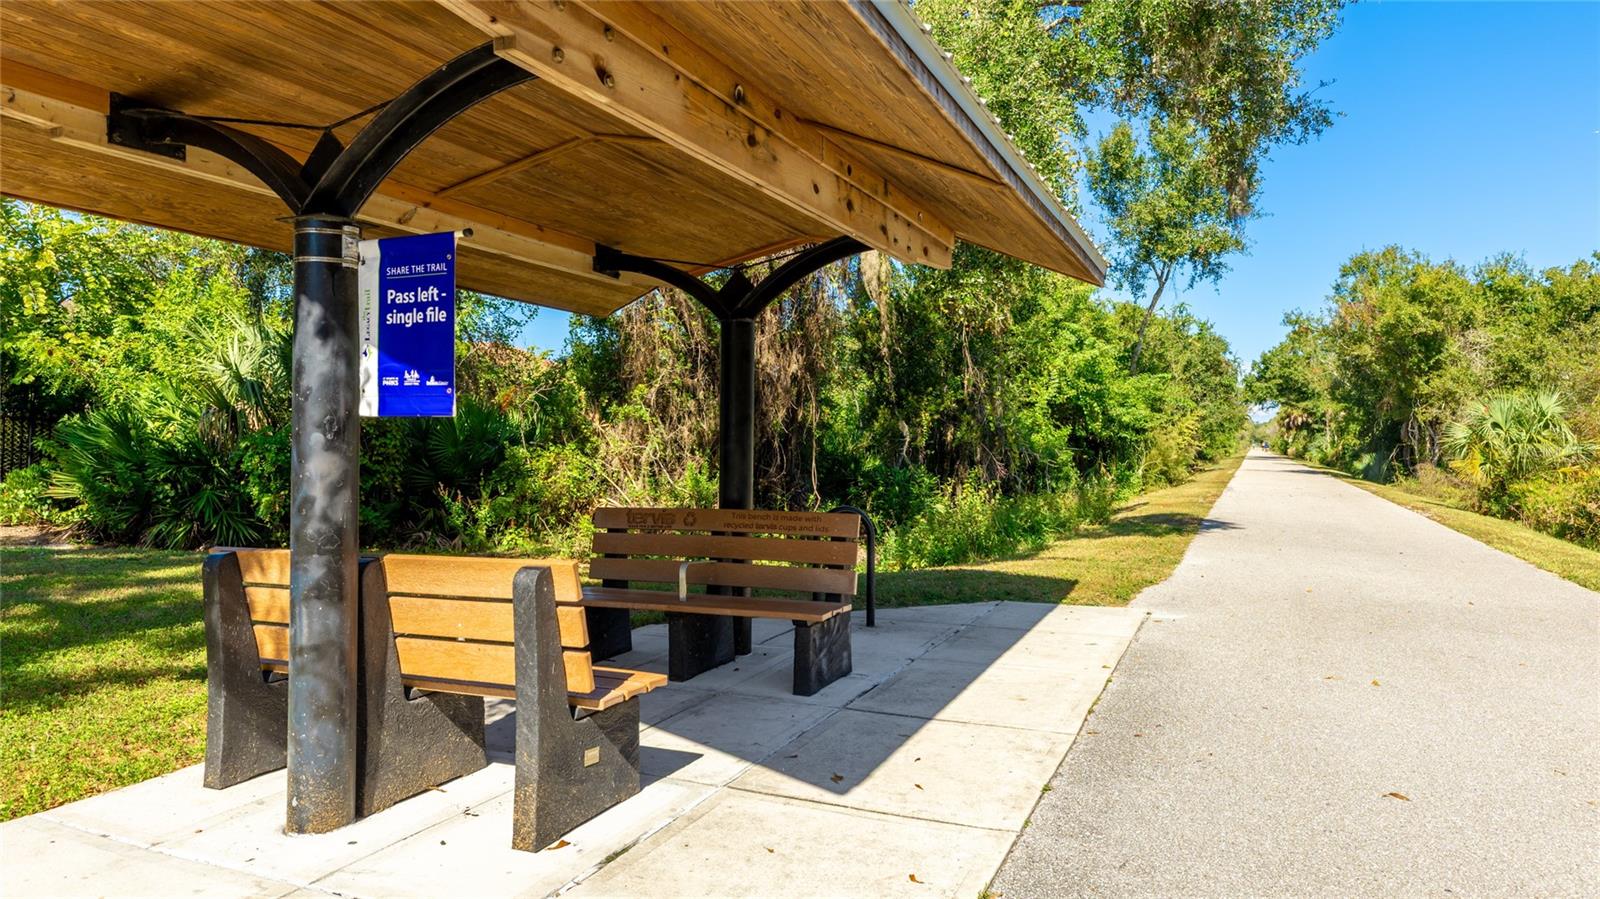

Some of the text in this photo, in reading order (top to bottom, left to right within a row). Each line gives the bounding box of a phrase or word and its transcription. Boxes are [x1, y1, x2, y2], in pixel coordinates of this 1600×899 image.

[386, 262, 448, 276] SHARE THE TRAIL
[387, 289, 415, 304] Pass
[417, 285, 439, 302] left
[386, 307, 424, 327] single
[426, 306, 447, 322] file
[731, 512, 747, 520] This
[748, 513, 771, 521] bench
[804, 515, 822, 523] with
[723, 522, 754, 530] recycled
[779, 524, 797, 532] cups
